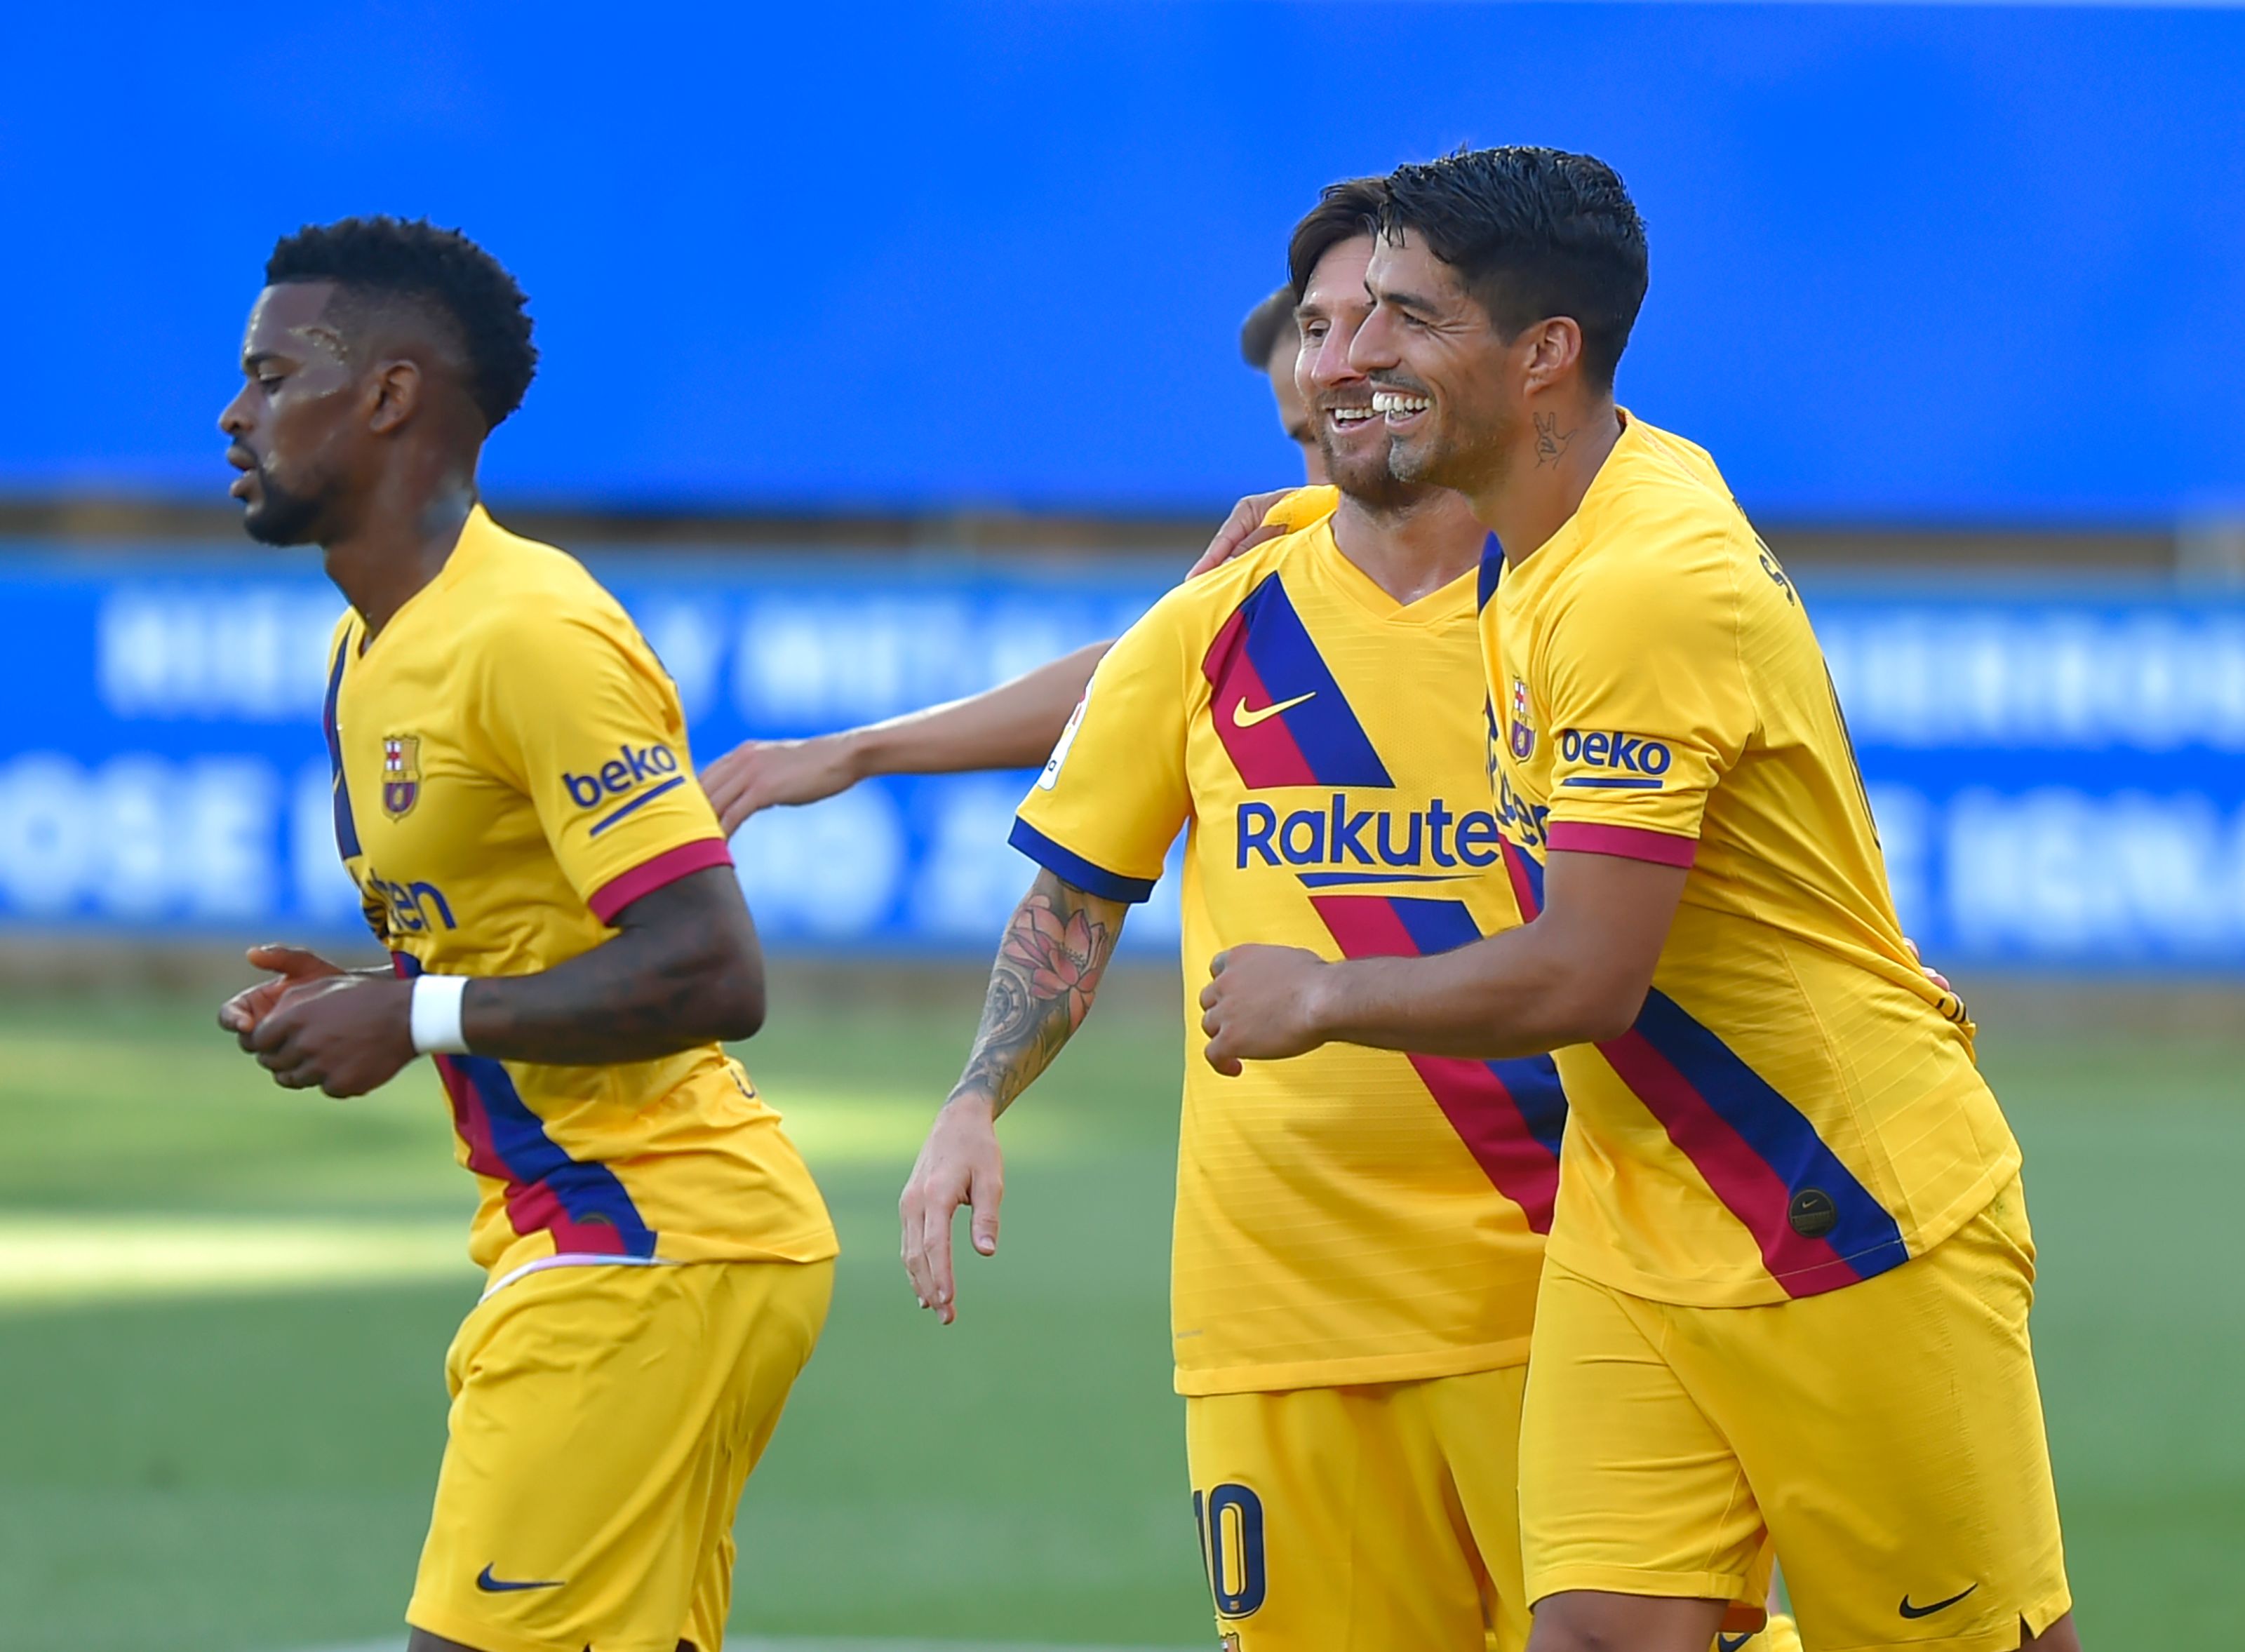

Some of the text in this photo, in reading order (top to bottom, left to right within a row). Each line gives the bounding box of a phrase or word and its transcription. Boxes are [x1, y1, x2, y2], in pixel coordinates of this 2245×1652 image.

[563, 744, 677, 809] beko
[1562, 729, 1672, 775] beko
[1237, 793, 1500, 869] Rakute
